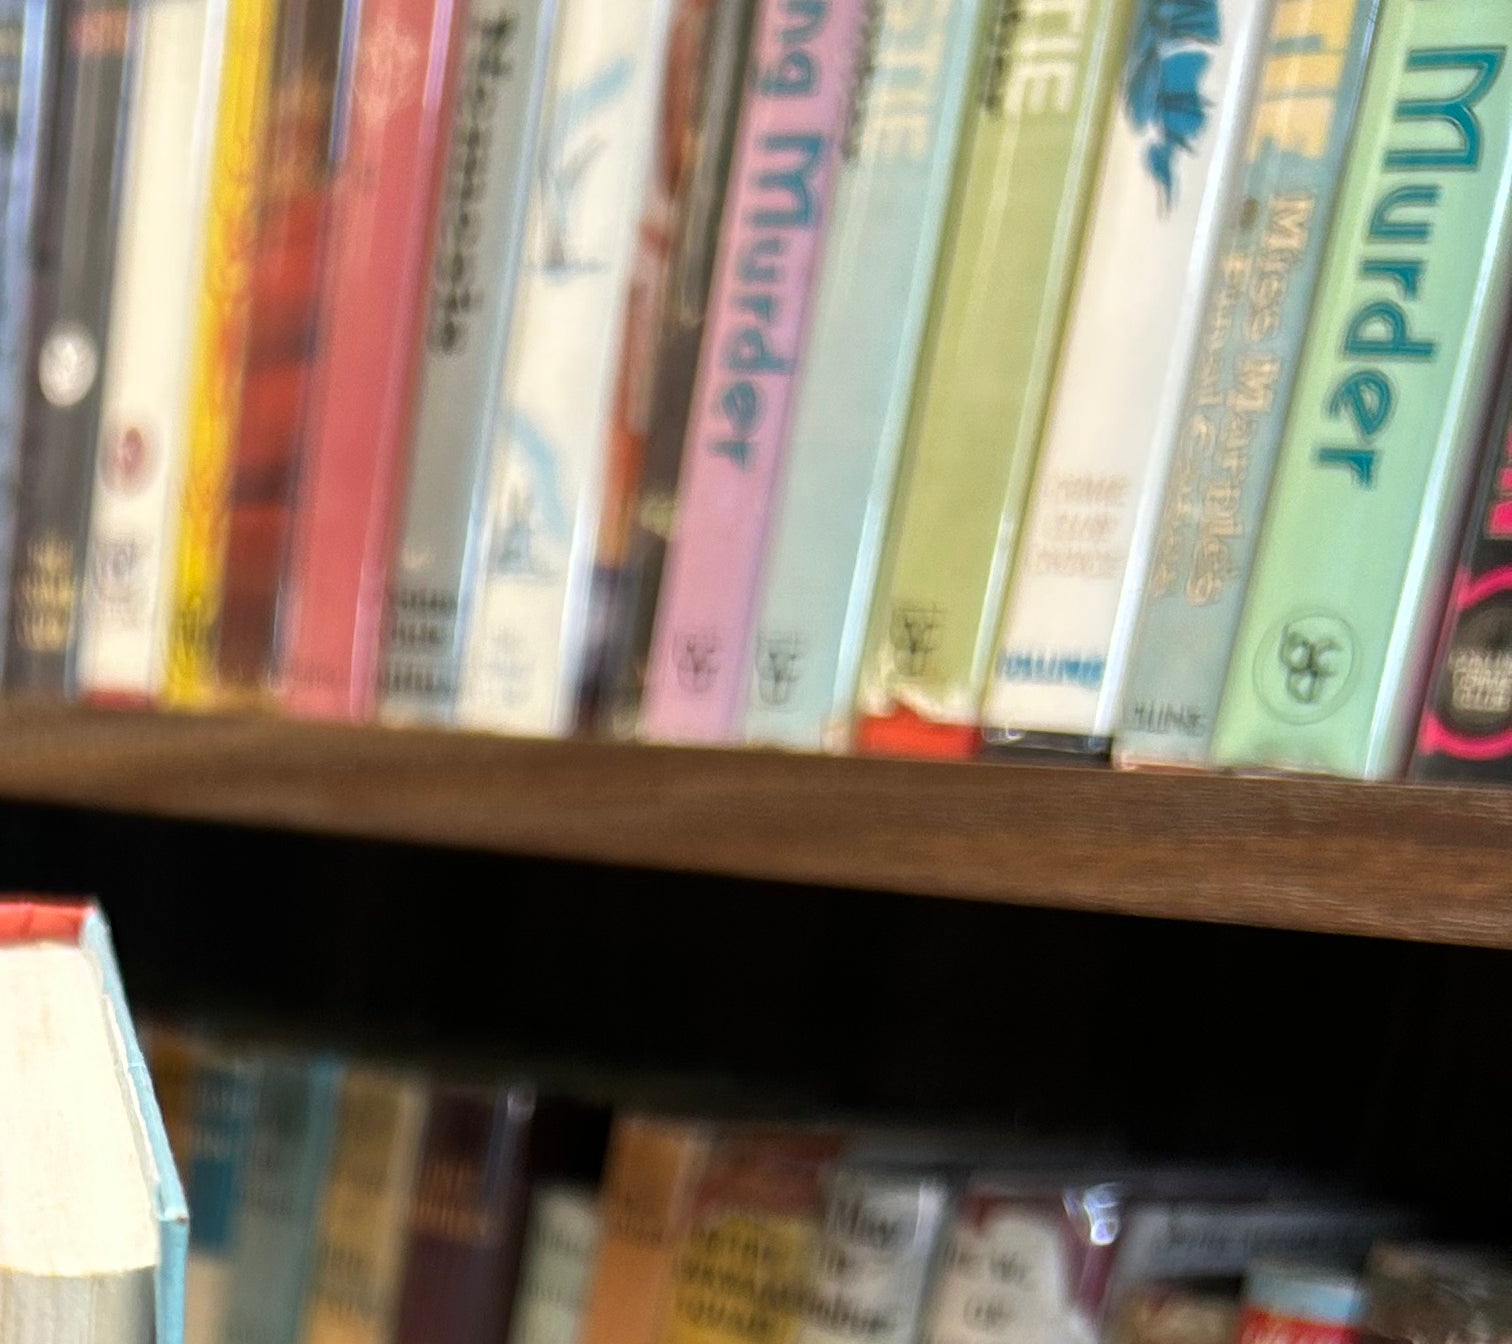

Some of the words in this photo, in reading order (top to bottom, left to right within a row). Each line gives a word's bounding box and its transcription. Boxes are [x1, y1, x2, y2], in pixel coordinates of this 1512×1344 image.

[706, 131, 829, 471] Murder
[1245, 192, 1316, 346] Miss
[1310, 43, 1508, 490] Murder
